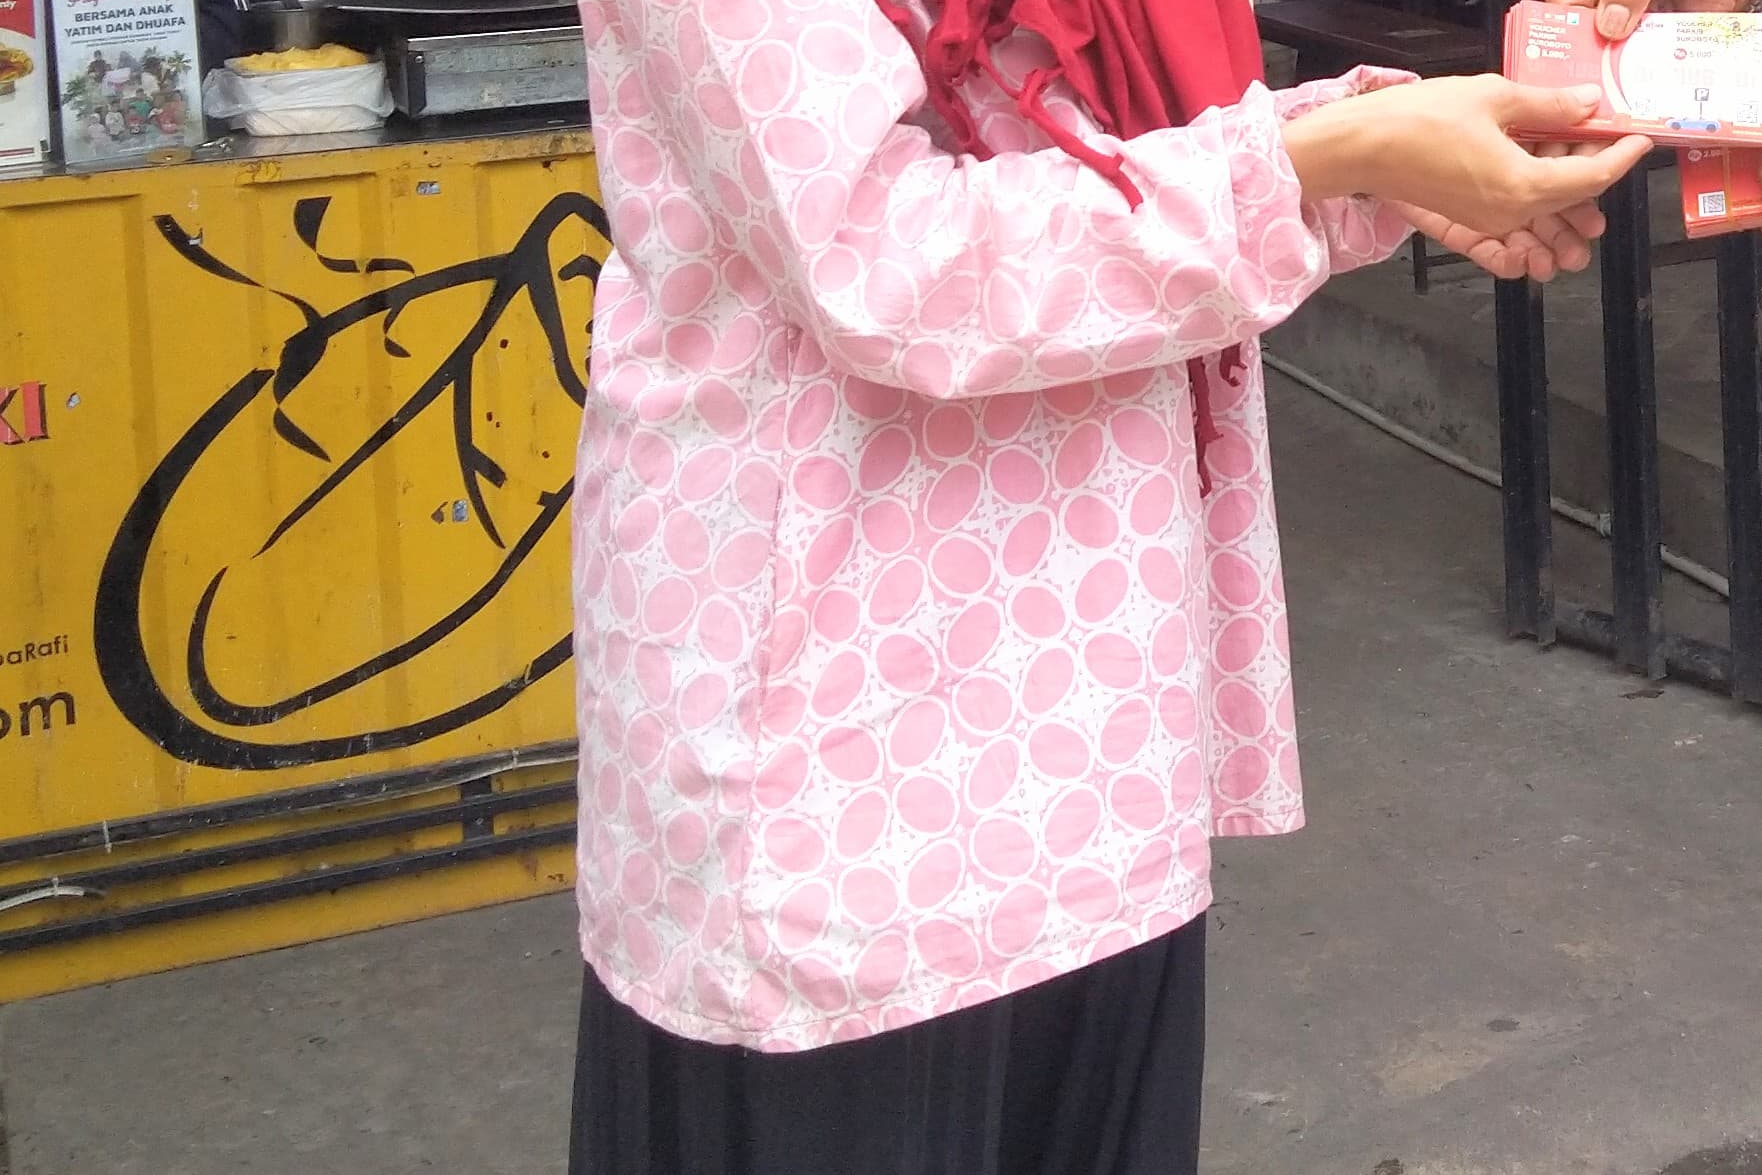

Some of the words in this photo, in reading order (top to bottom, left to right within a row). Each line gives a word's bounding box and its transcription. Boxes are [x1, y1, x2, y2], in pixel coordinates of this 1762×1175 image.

[75, 8, 135, 23] BERSAMA
[139, 4, 173, 16] ANAK
[65, 25, 103, 38] YATIM
[105, 22, 132, 33] DAN
[135, 17, 186, 30] DHUAFA
[0, 635, 69, 665] aRafi
